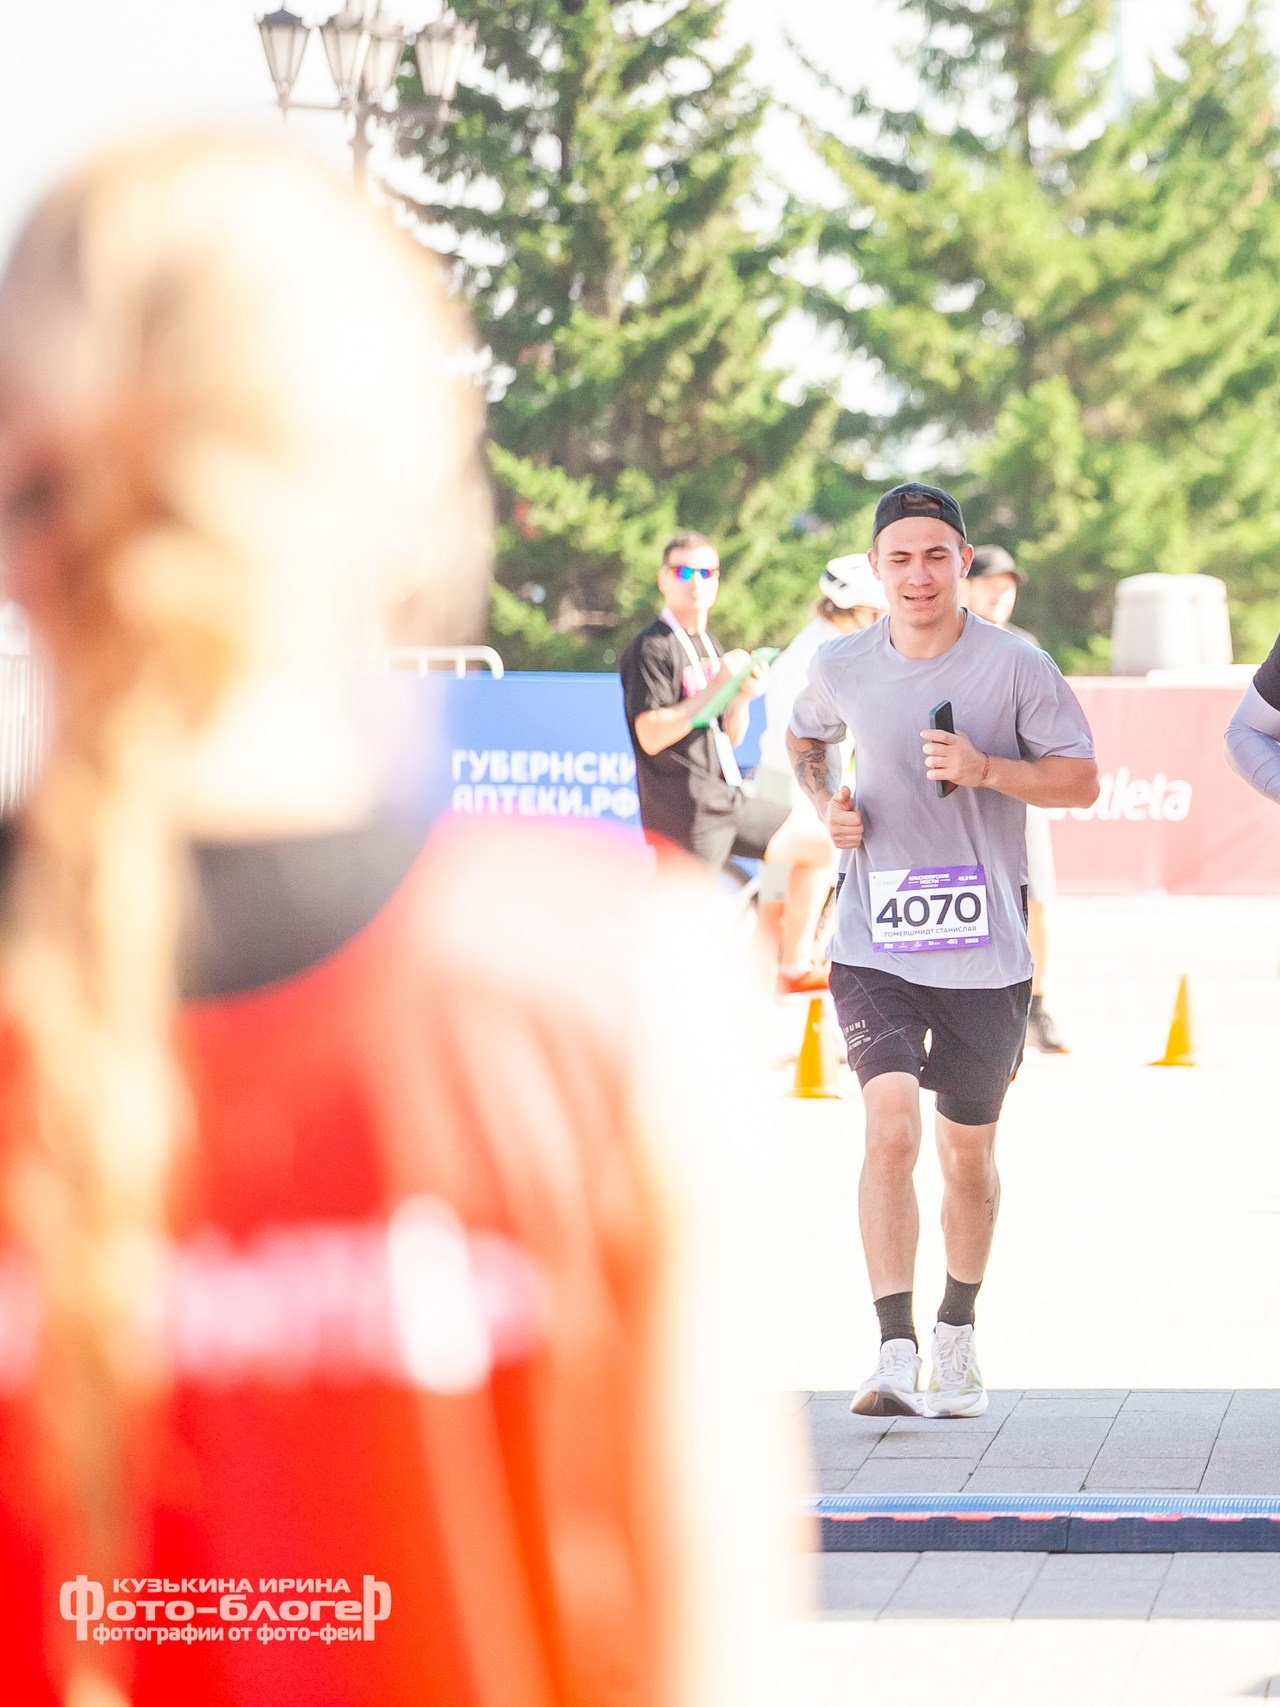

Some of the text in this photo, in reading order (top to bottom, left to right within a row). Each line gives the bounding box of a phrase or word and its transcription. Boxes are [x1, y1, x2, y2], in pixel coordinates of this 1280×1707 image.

[452, 784, 639, 818] АПТЕКИ.РФ
[876, 892, 981, 928] 4070
[936, 926, 977, 934] СТАНИСЛАВ
